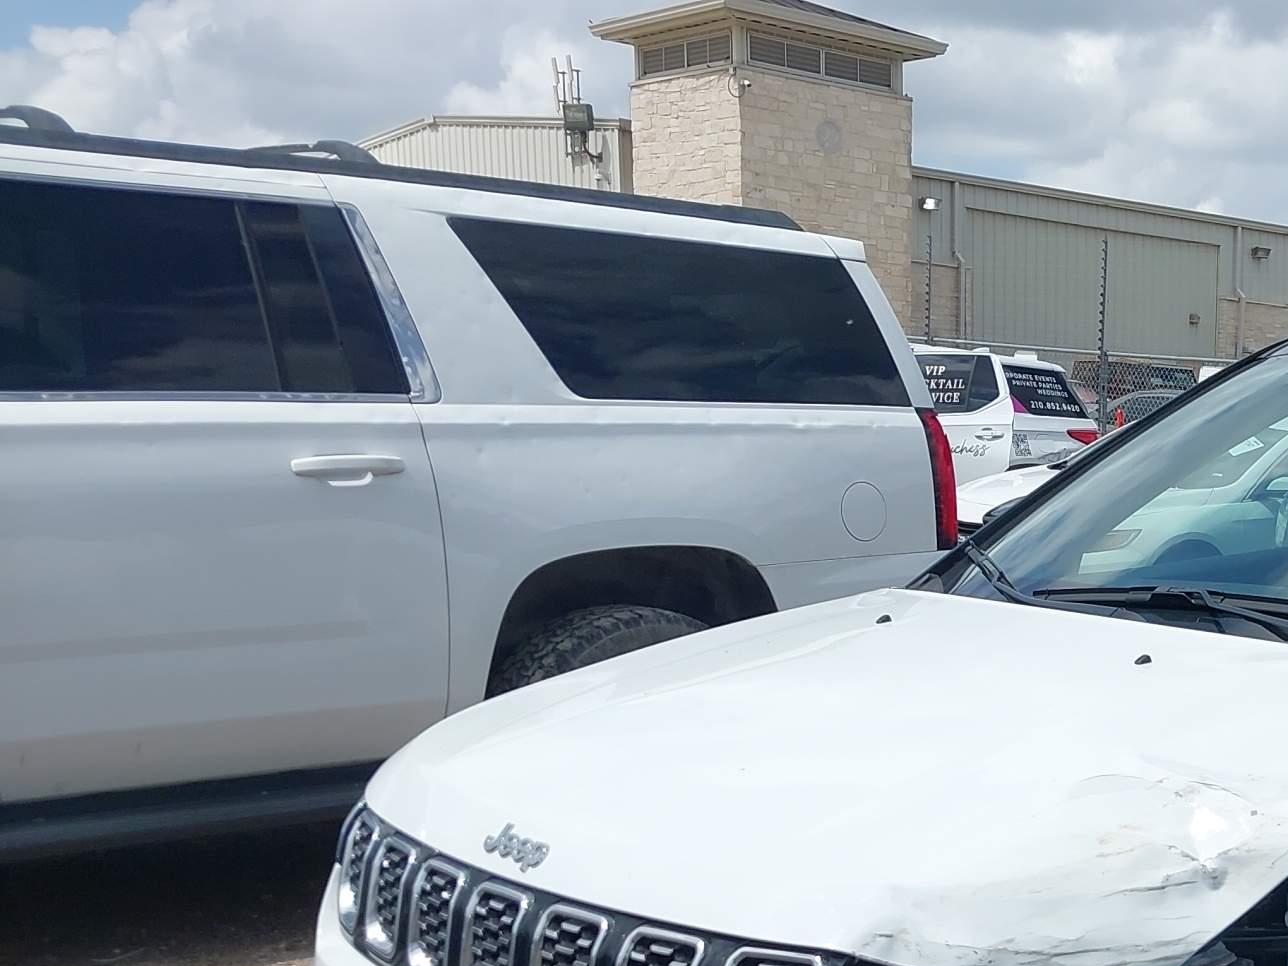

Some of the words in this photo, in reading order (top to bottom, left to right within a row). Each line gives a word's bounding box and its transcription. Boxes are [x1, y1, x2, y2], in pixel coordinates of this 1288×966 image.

[924, 365, 946, 376] VIP
[1012, 379, 1038, 388] PRIVATE
[1035, 374, 1057, 383] EVENTS
[483, 822, 550, 873] Jeep
